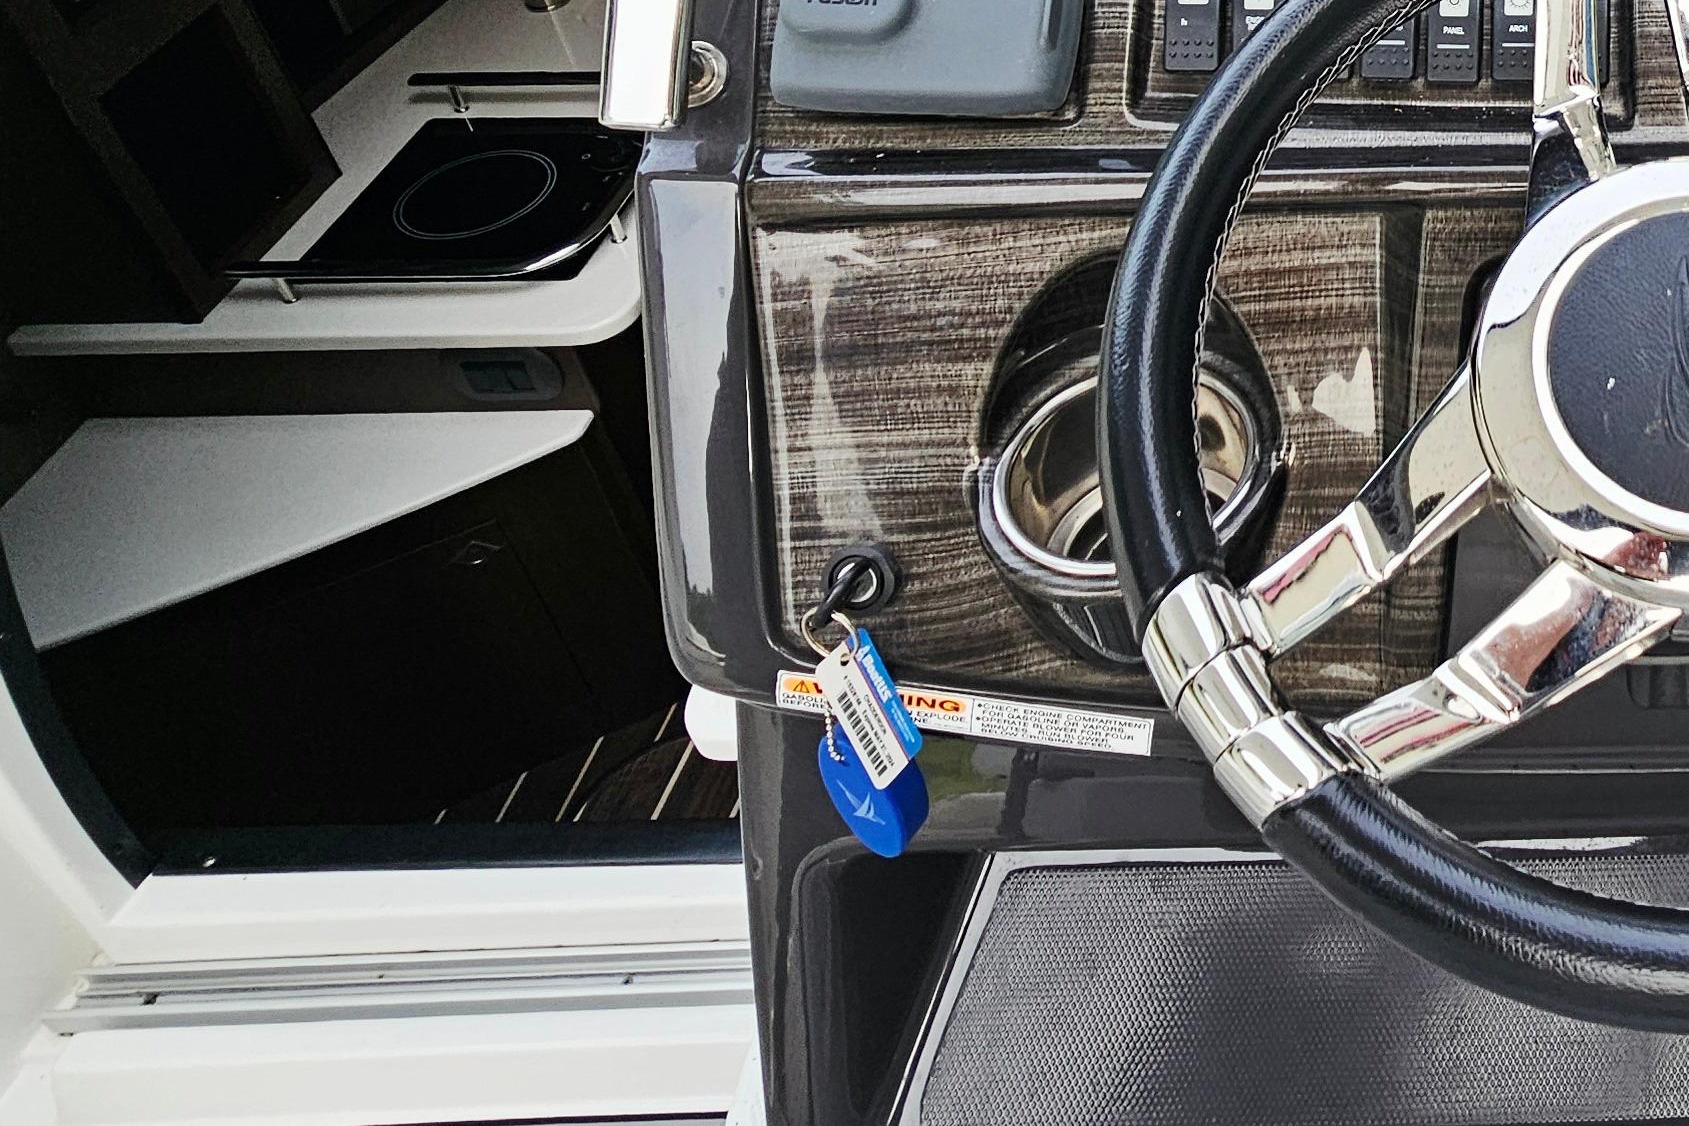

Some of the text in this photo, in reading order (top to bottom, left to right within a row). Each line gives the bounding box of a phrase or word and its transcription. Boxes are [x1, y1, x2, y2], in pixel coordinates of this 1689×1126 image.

[1442, 26, 1465, 35] PANEL
[1508, 25, 1528, 33] ARCH
[862, 656, 893, 704] BoatUS
[916, 710, 967, 723] EXPLODE.
[982, 709, 1003, 717] FOR
[1007, 712, 1060, 725] GASOLINE
[983, 702, 1147, 730] CHECK ENGINE COMPARTMENT
[981, 715, 1134, 741] OPERATE BLOWER FOR FOUR
[1021, 732, 1073, 745] CRUISING
[1038, 729, 1060, 737] RUN
[1064, 733, 1108, 744] BLOWER
